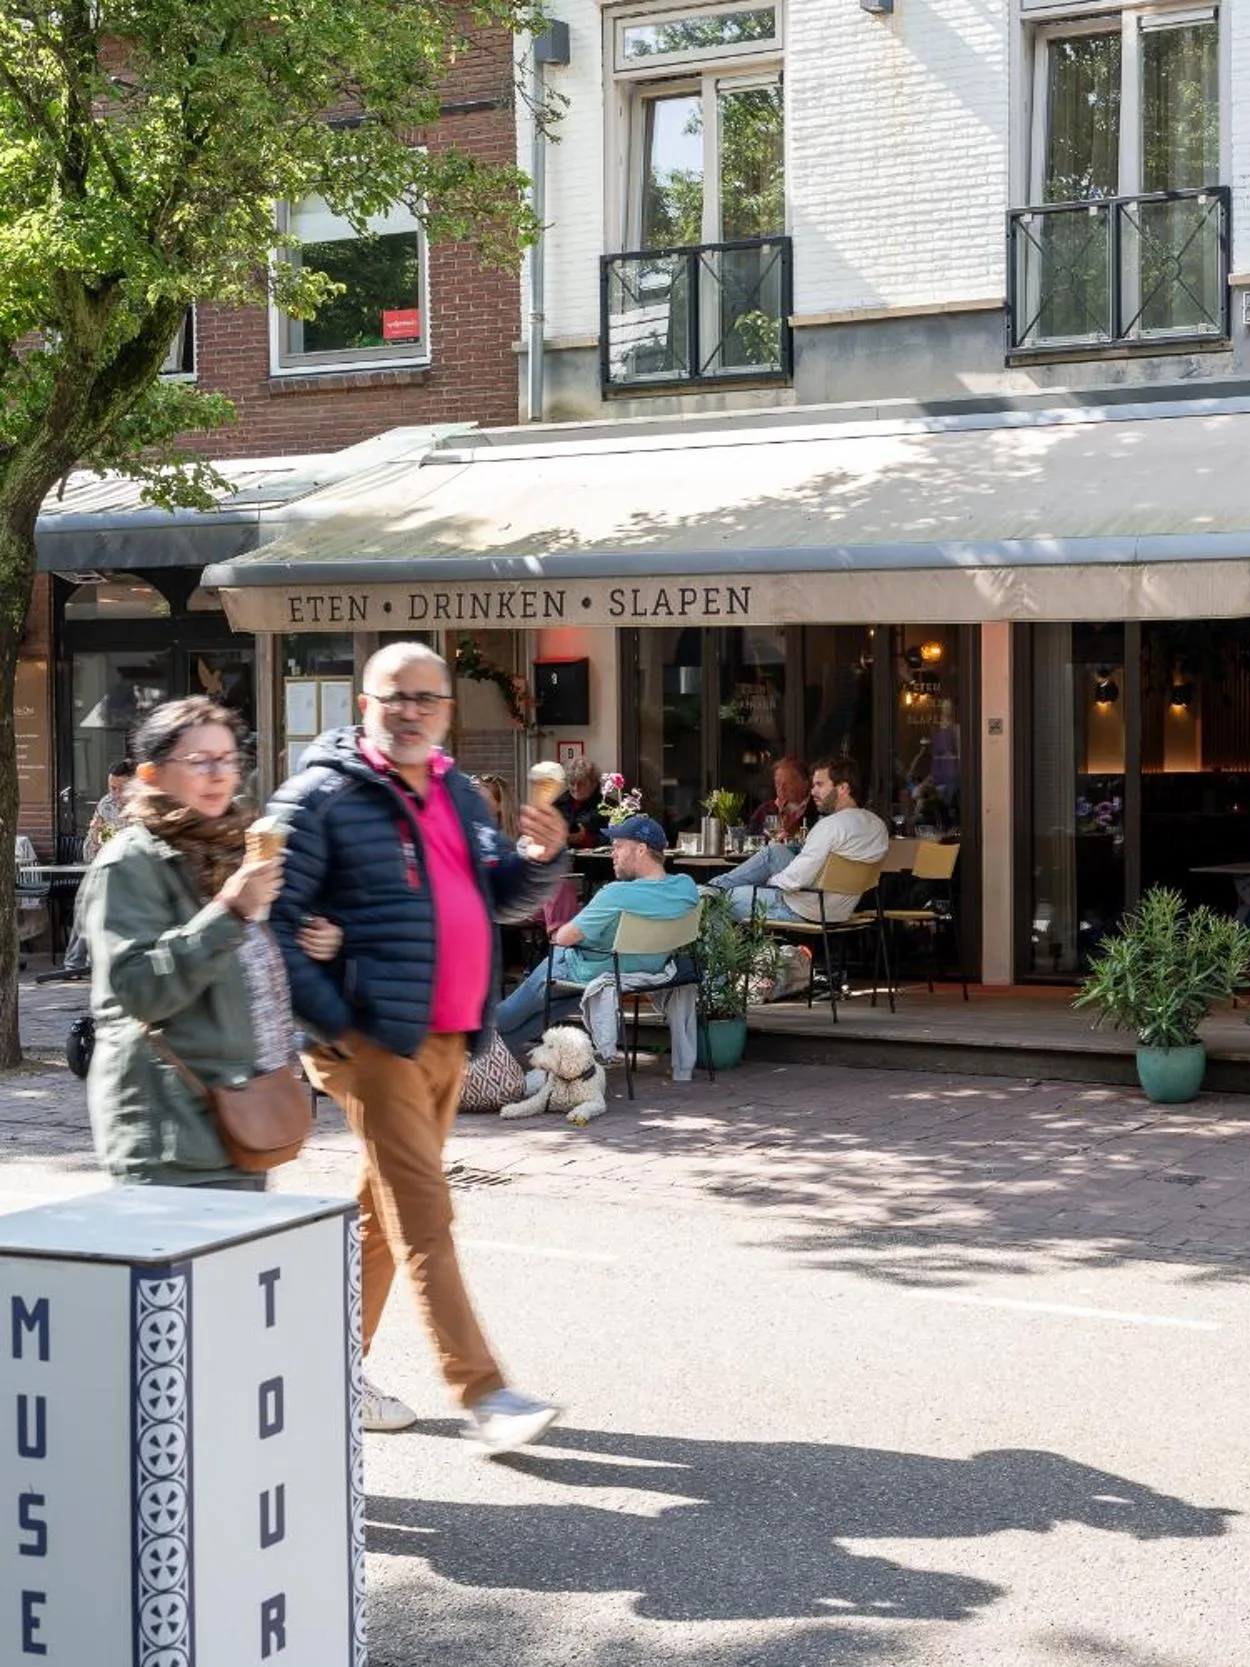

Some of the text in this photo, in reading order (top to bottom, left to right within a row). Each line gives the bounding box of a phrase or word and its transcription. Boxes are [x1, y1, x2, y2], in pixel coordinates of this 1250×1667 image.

[288, 586, 752, 623] ETEN DRINKEN SLAPEN
[11, 1295, 51, 1656] MUSE
[257, 1266, 287, 1660] TOUR
